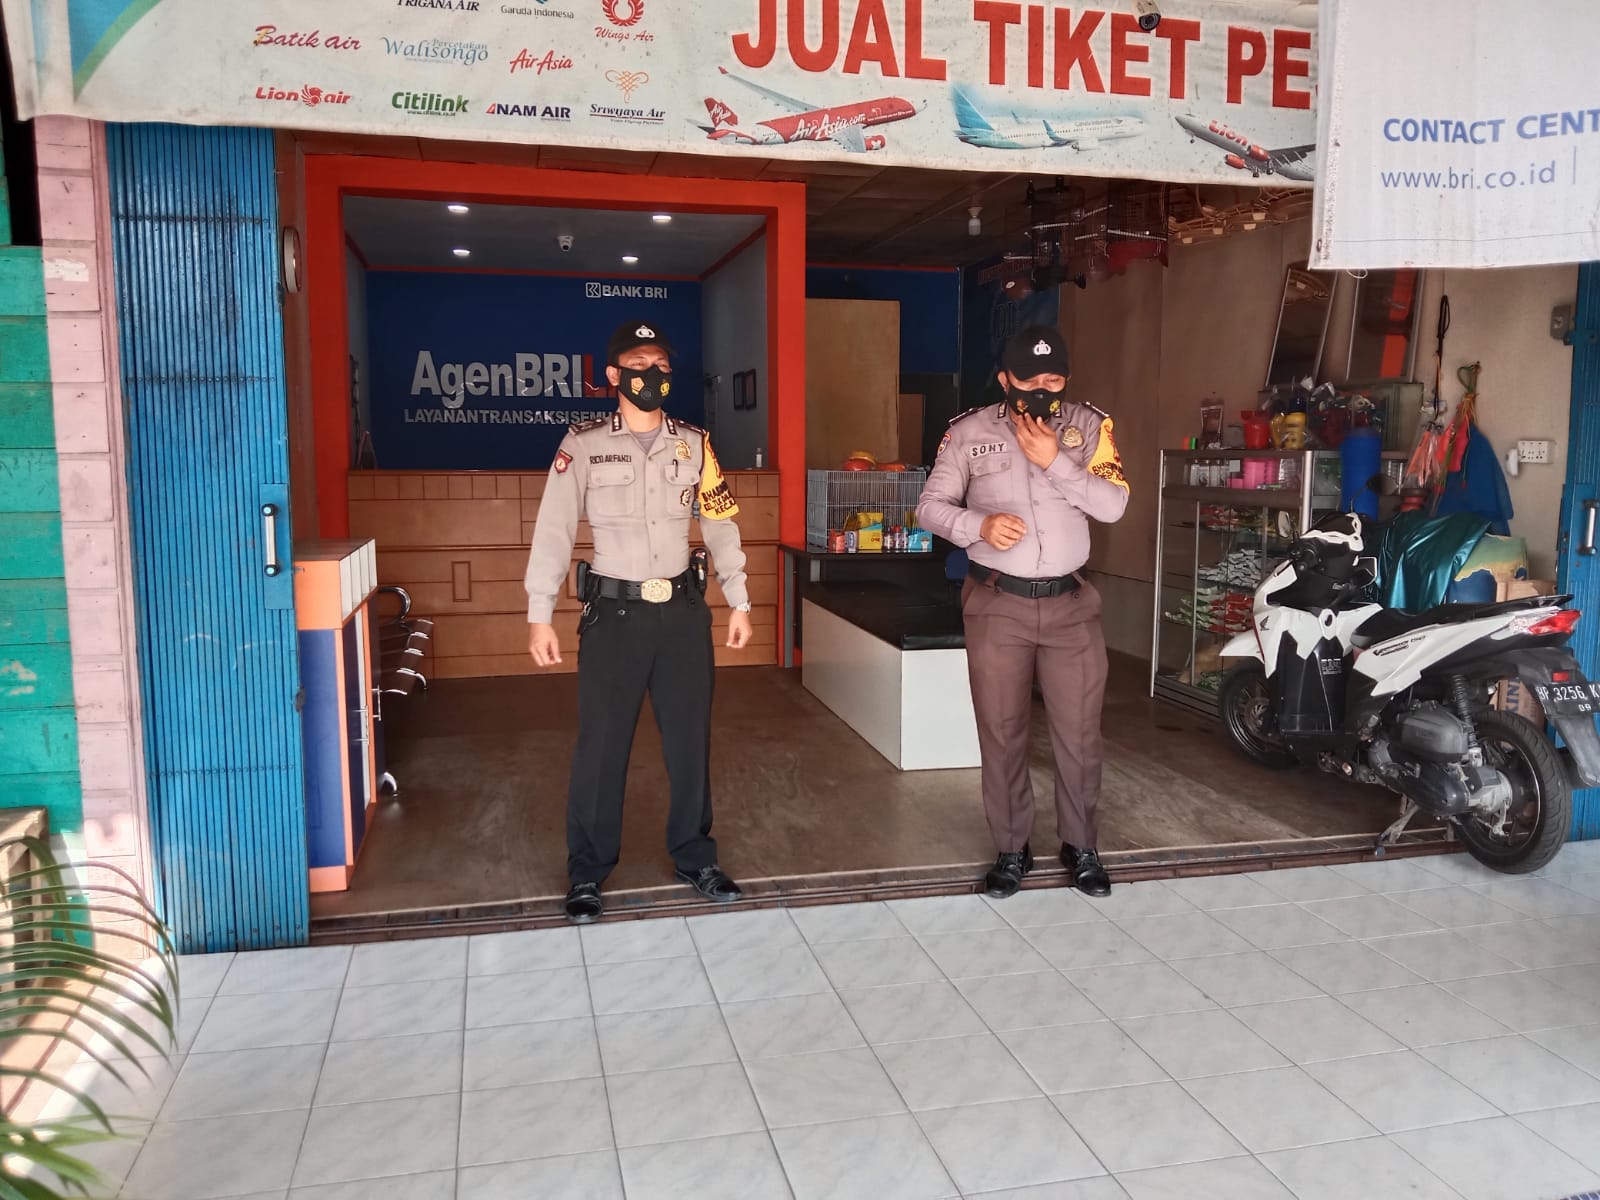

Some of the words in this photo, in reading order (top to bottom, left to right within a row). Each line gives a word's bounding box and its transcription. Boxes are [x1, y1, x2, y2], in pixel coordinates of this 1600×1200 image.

[455, 0, 480, 11] AIR
[501, 5, 532, 16] Garuda
[534, 8, 574, 19] Indonesia
[253, 25, 320, 48] Batik
[324, 36, 361, 50] air
[595, 27, 630, 42] Wings
[633, 30, 654, 42] Air
[381, 37, 489, 66] Walisongo
[731, 0, 947, 81] JUAL
[974, 0, 1200, 99] TIKET
[1226, 26, 1317, 109] PE
[255, 86, 299, 101] Lion
[324, 91, 352, 104] air
[392, 92, 469, 113] Citilink
[541, 106, 571, 118] AIR
[646, 108, 666, 118] Air
[1208, 119, 1248, 146] Lion
[1383, 118, 1505, 144] CONTACT
[1516, 109, 1600, 139] CENT
[1381, 160, 1556, 190] www.bri.co.id
[602, 284, 642, 298] BANK
[644, 286, 667, 299] BRI
[404, 409, 479, 423] LAYANAN
[480, 410, 569, 425] TRANSAKSI
[972, 443, 1004, 457] SONY
[1553, 685, 1586, 701] 3256
[1588, 683, 1600, 698] K
